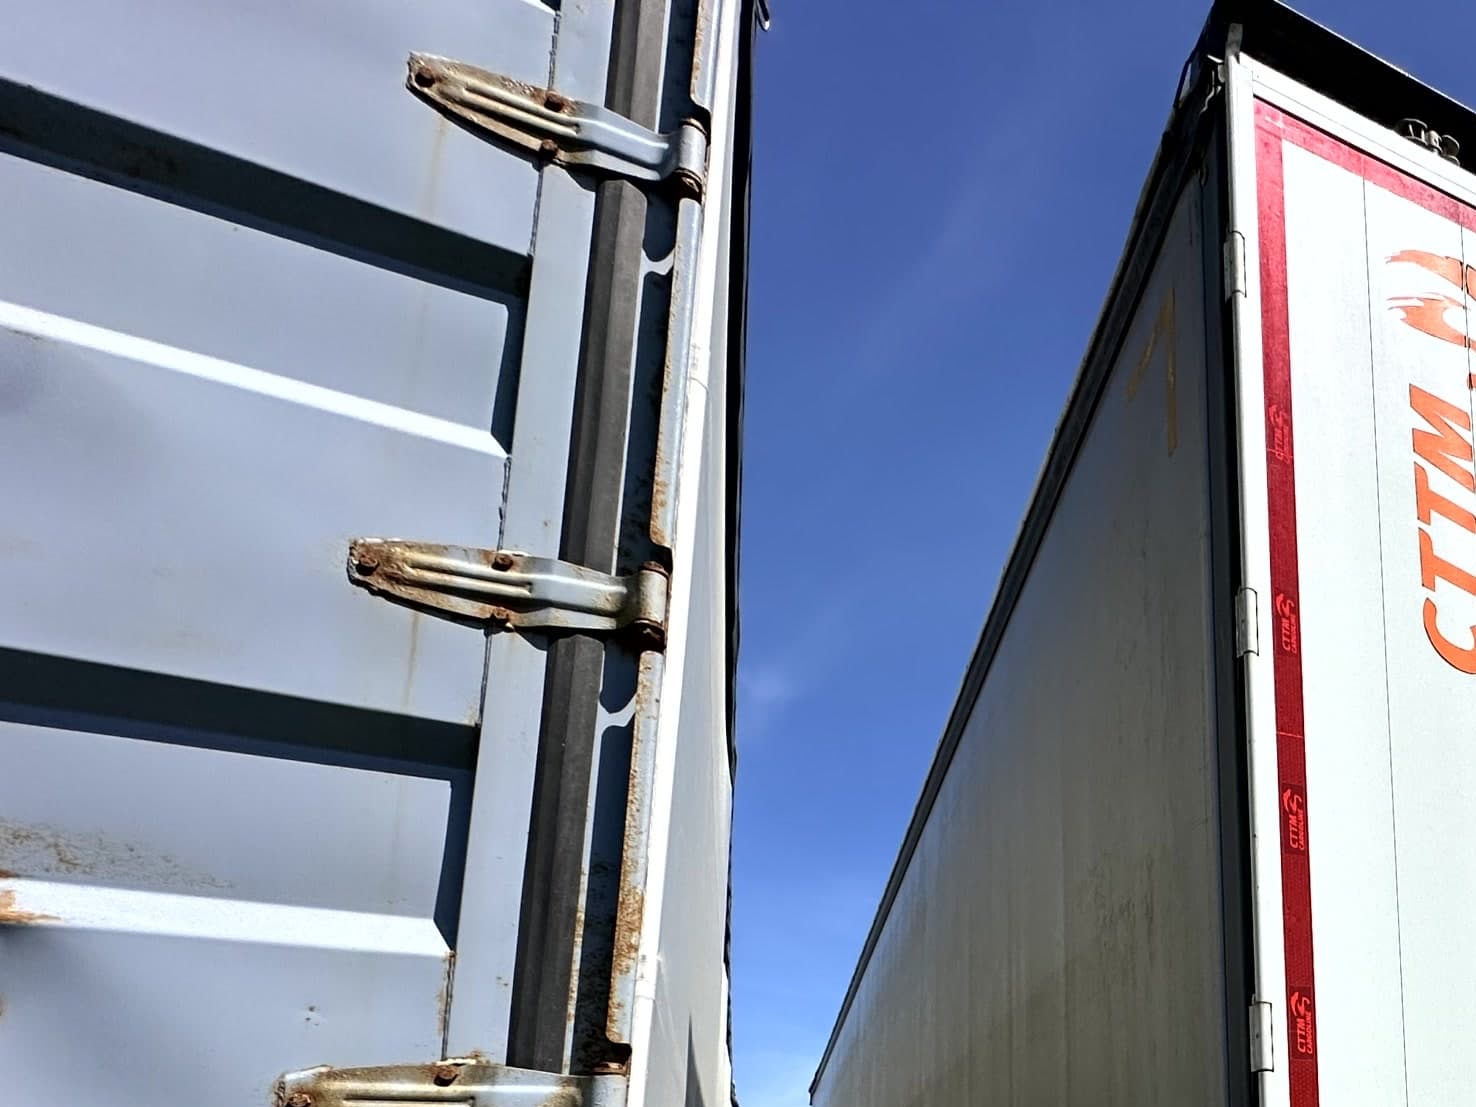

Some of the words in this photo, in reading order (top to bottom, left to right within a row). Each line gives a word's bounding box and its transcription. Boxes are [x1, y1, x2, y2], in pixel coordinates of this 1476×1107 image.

[1281, 617, 1290, 651] CTTM
[1289, 813, 1298, 849] CTTM
[1297, 1017, 1306, 1053] CTTM
